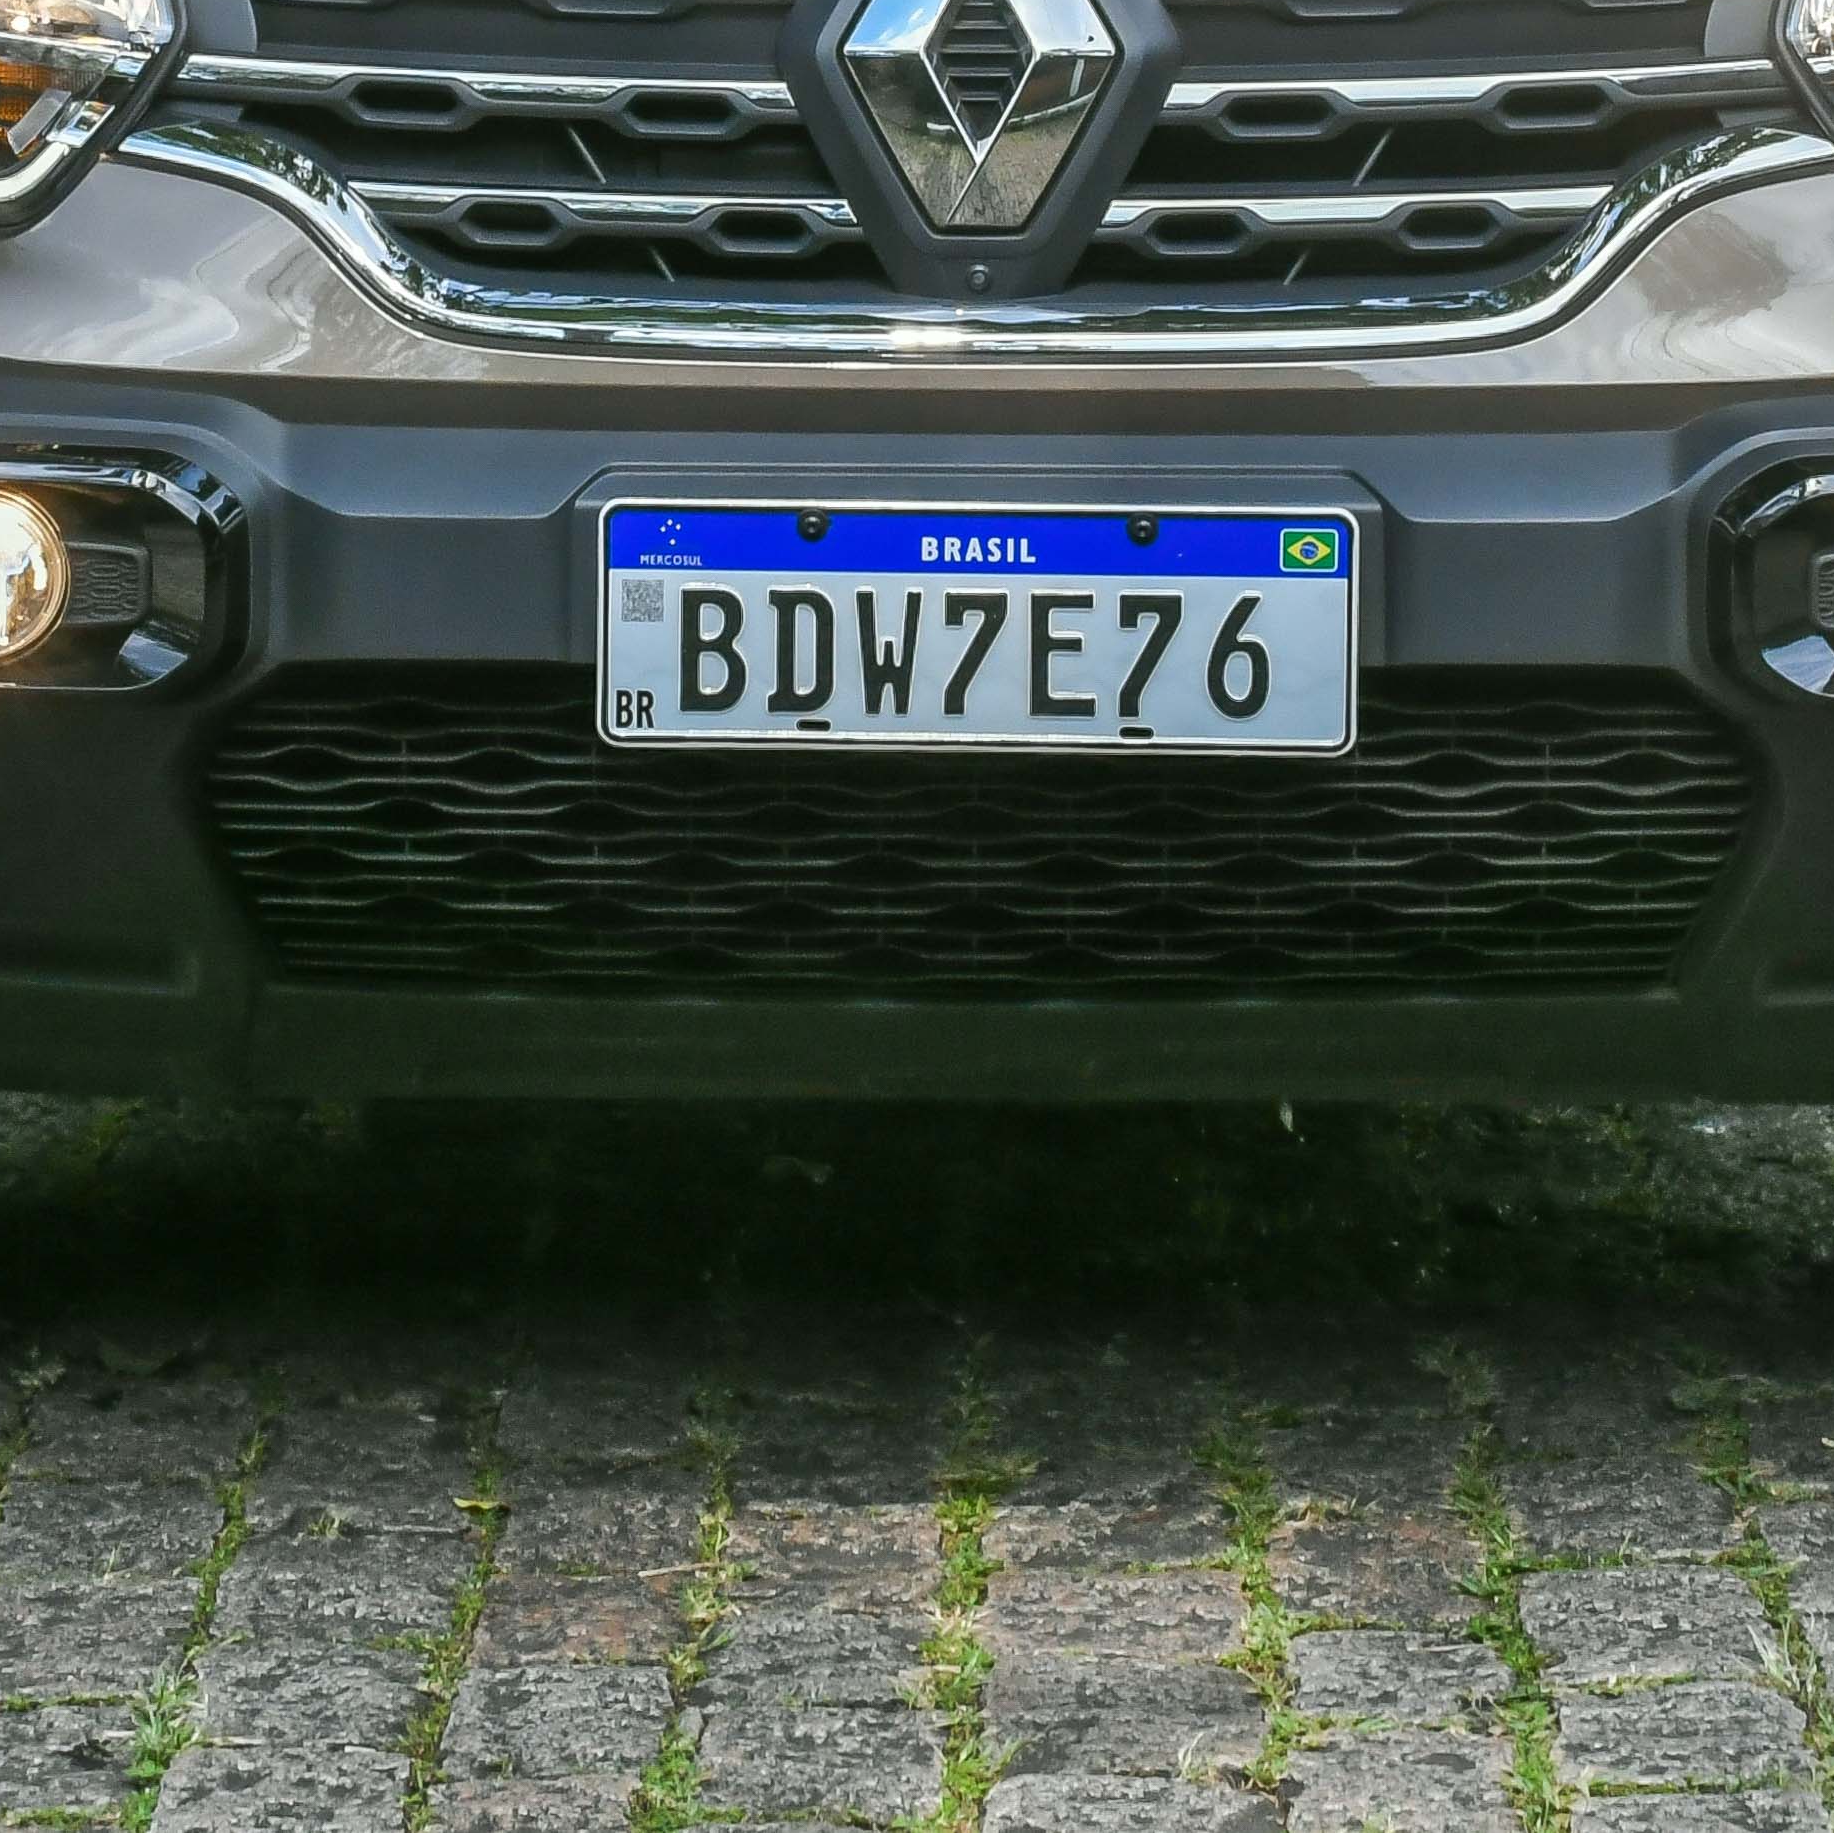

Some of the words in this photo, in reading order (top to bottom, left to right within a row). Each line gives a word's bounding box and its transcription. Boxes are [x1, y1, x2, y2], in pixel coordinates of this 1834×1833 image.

[640, 554, 703, 567] MERCOSUL
[921, 536, 1037, 563] BRASIL
[679, 585, 1270, 719] BDW7E76
[616, 690, 655, 729] BR
